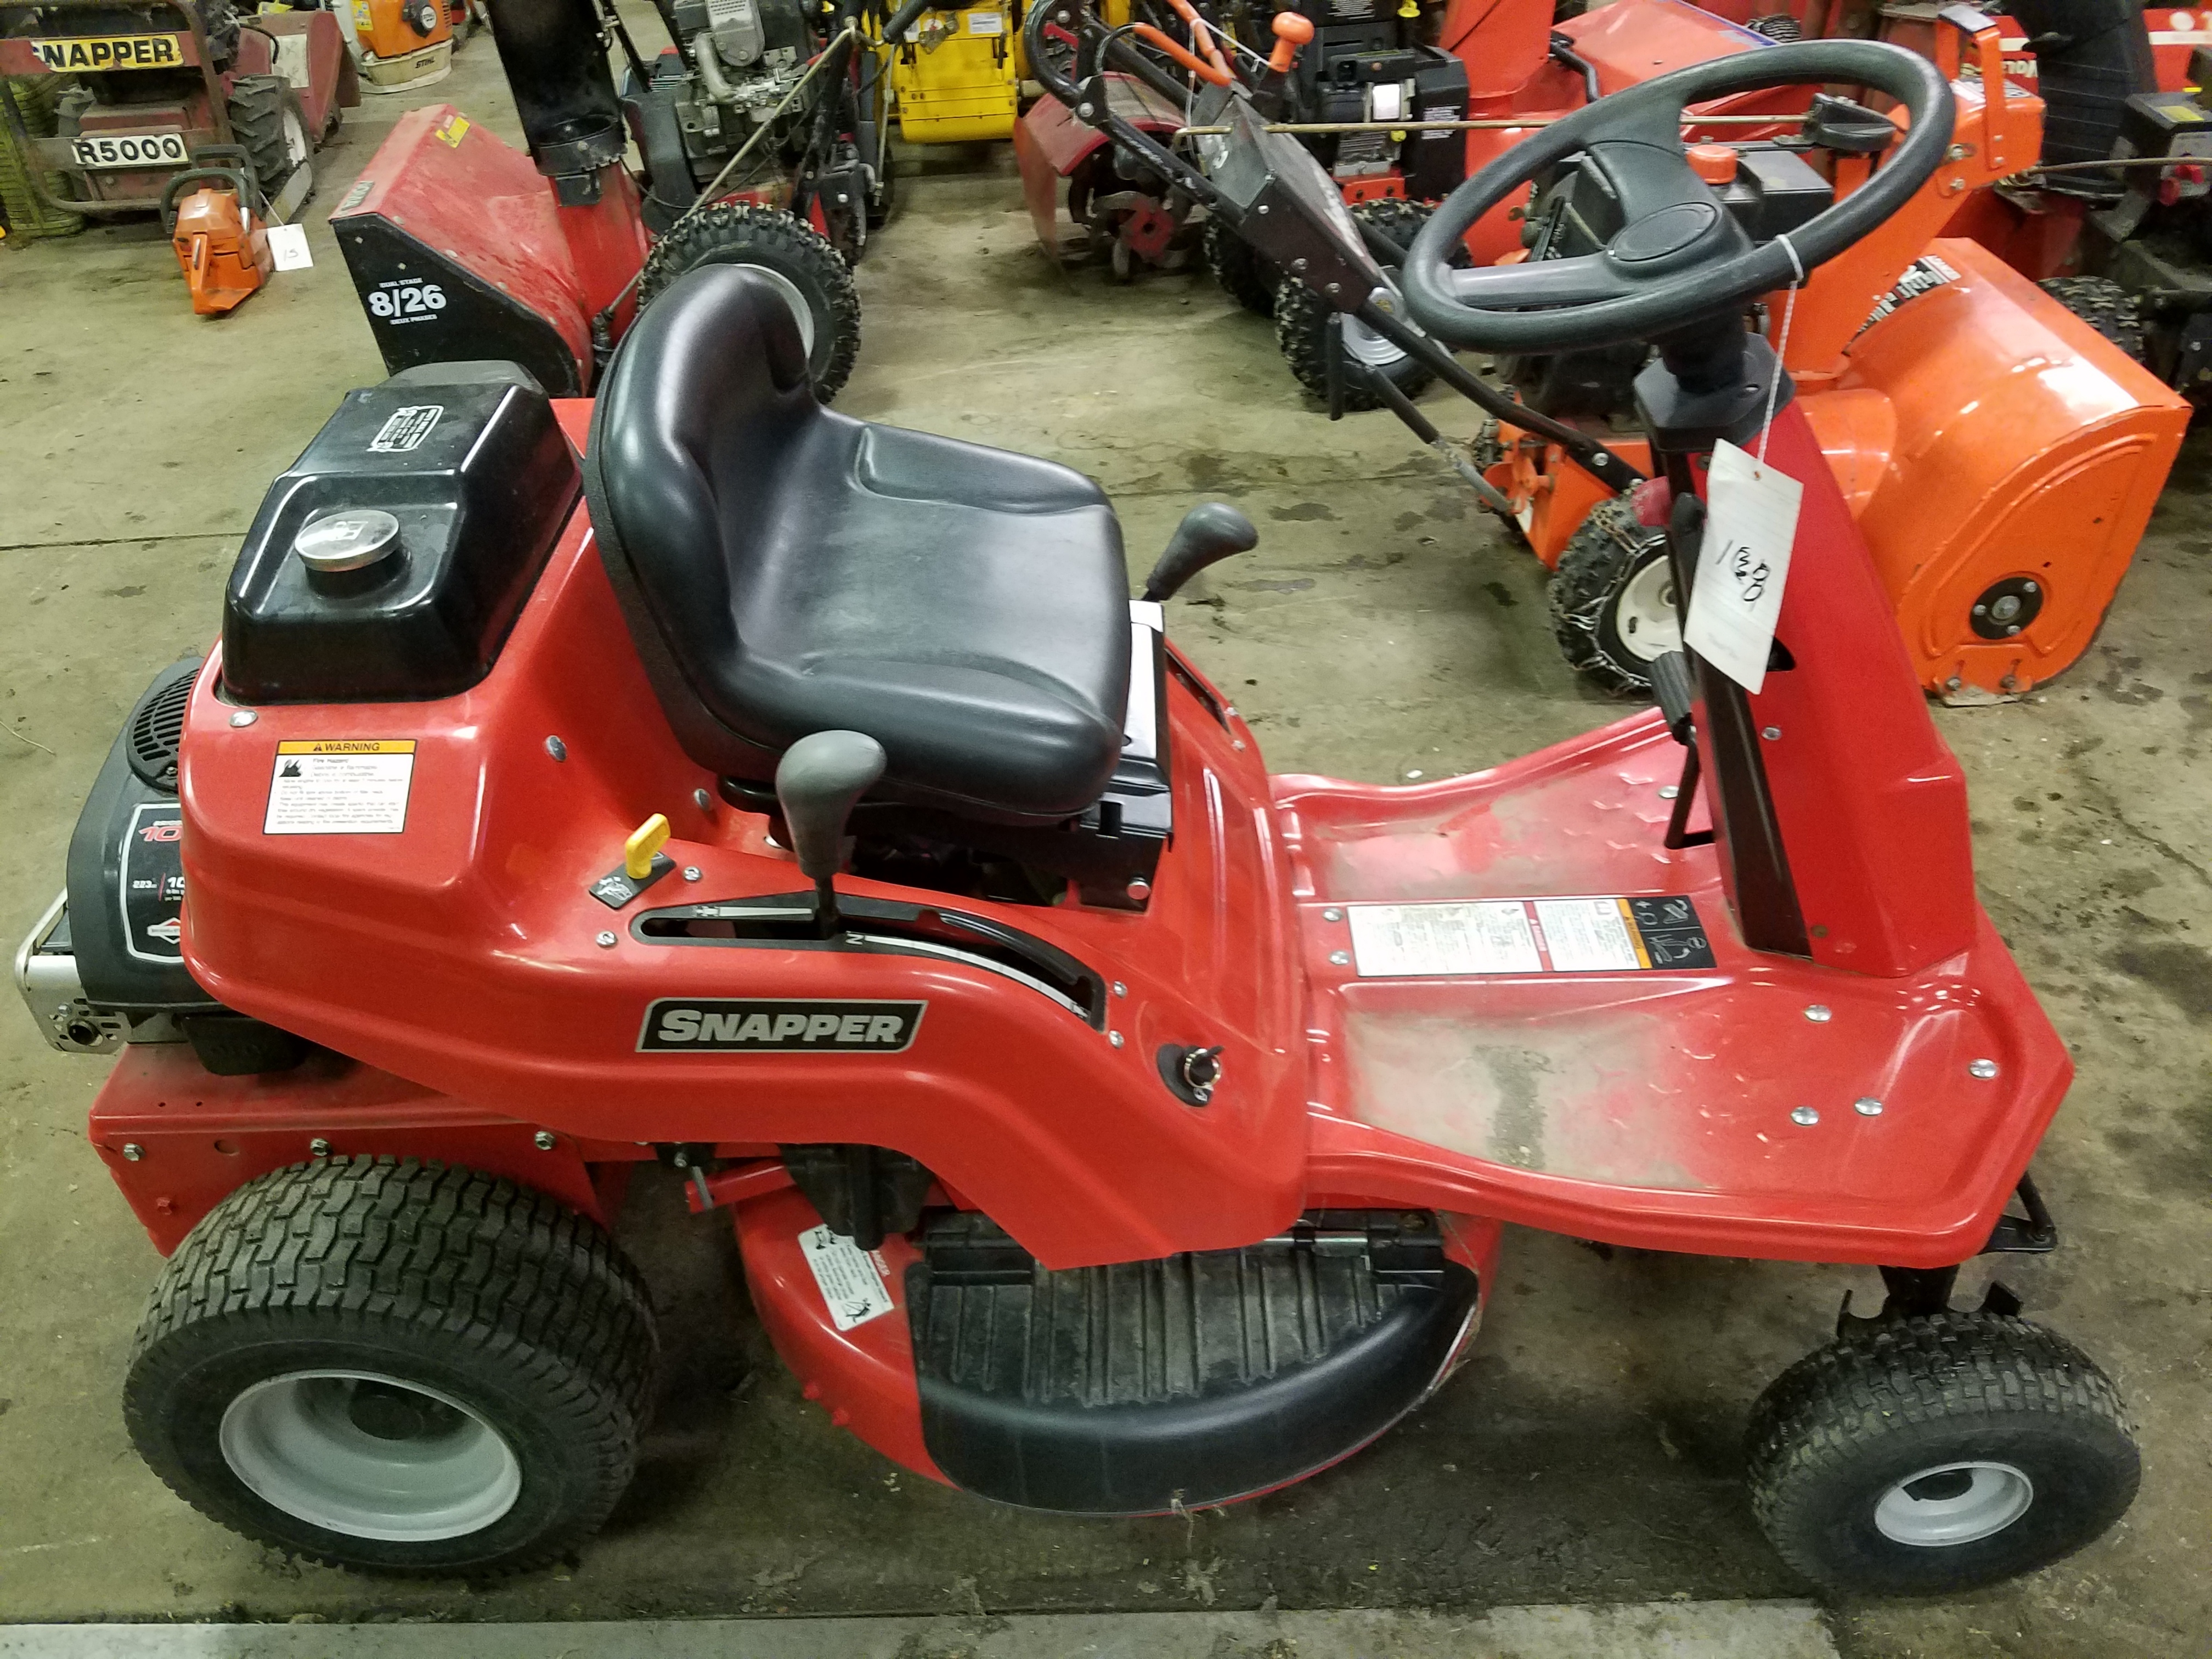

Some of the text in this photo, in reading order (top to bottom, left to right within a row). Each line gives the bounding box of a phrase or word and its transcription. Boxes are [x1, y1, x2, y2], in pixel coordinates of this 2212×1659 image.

[32, 38, 174, 67] NAPPER
[76, 137, 182, 163] R5000
[325, 743, 380, 751] WARNING
[658, 1009, 904, 1042] SNAPPER
